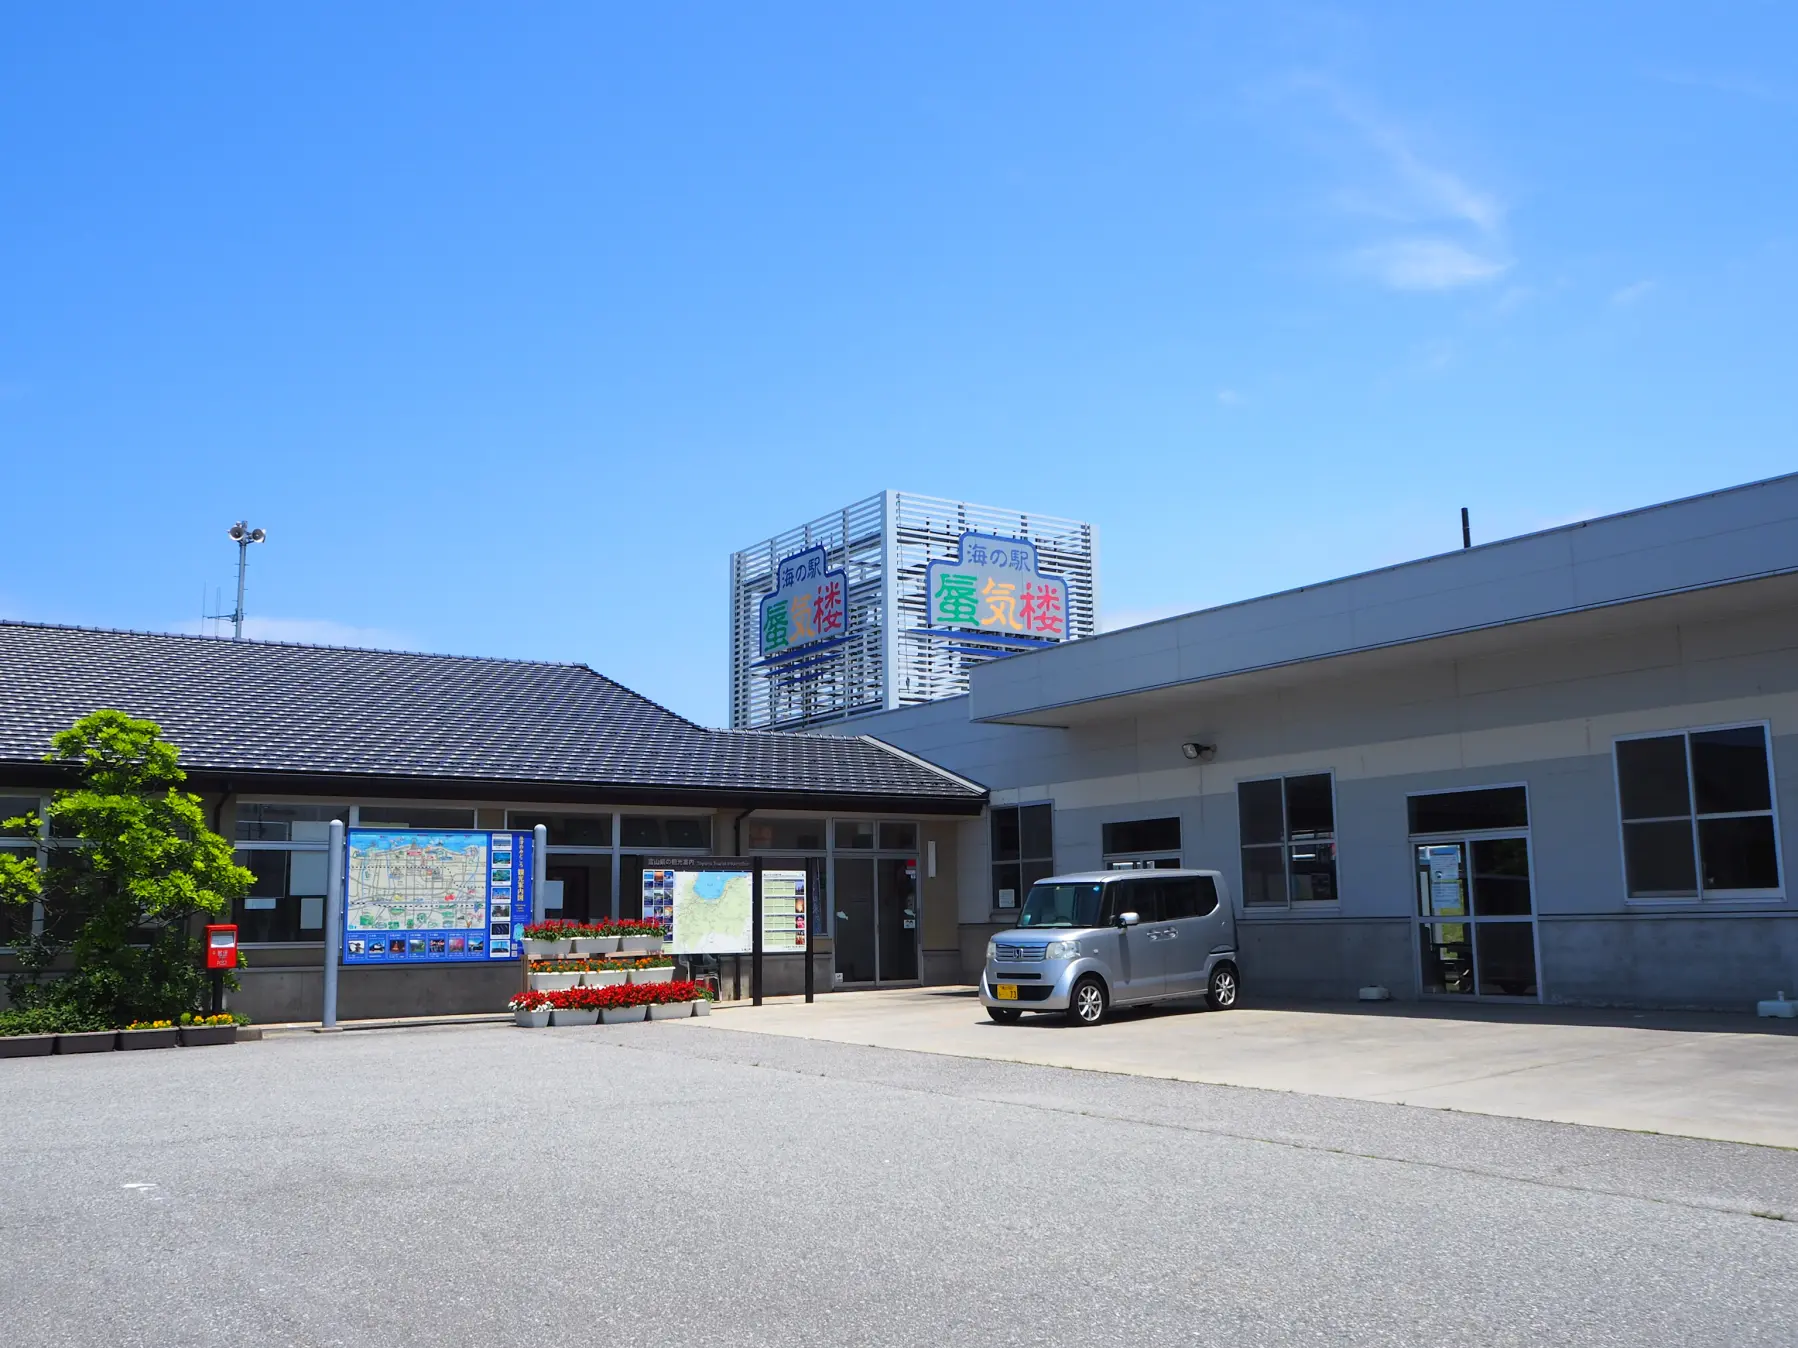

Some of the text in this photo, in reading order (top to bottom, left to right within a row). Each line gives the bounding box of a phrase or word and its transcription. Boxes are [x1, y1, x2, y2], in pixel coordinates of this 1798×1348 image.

[781, 557, 822, 589] 海の駅
[967, 542, 1031, 573] 海の駅
[763, 581, 844, 652] 蜃気楼
[934, 573, 1065, 634] 蜃気楼
